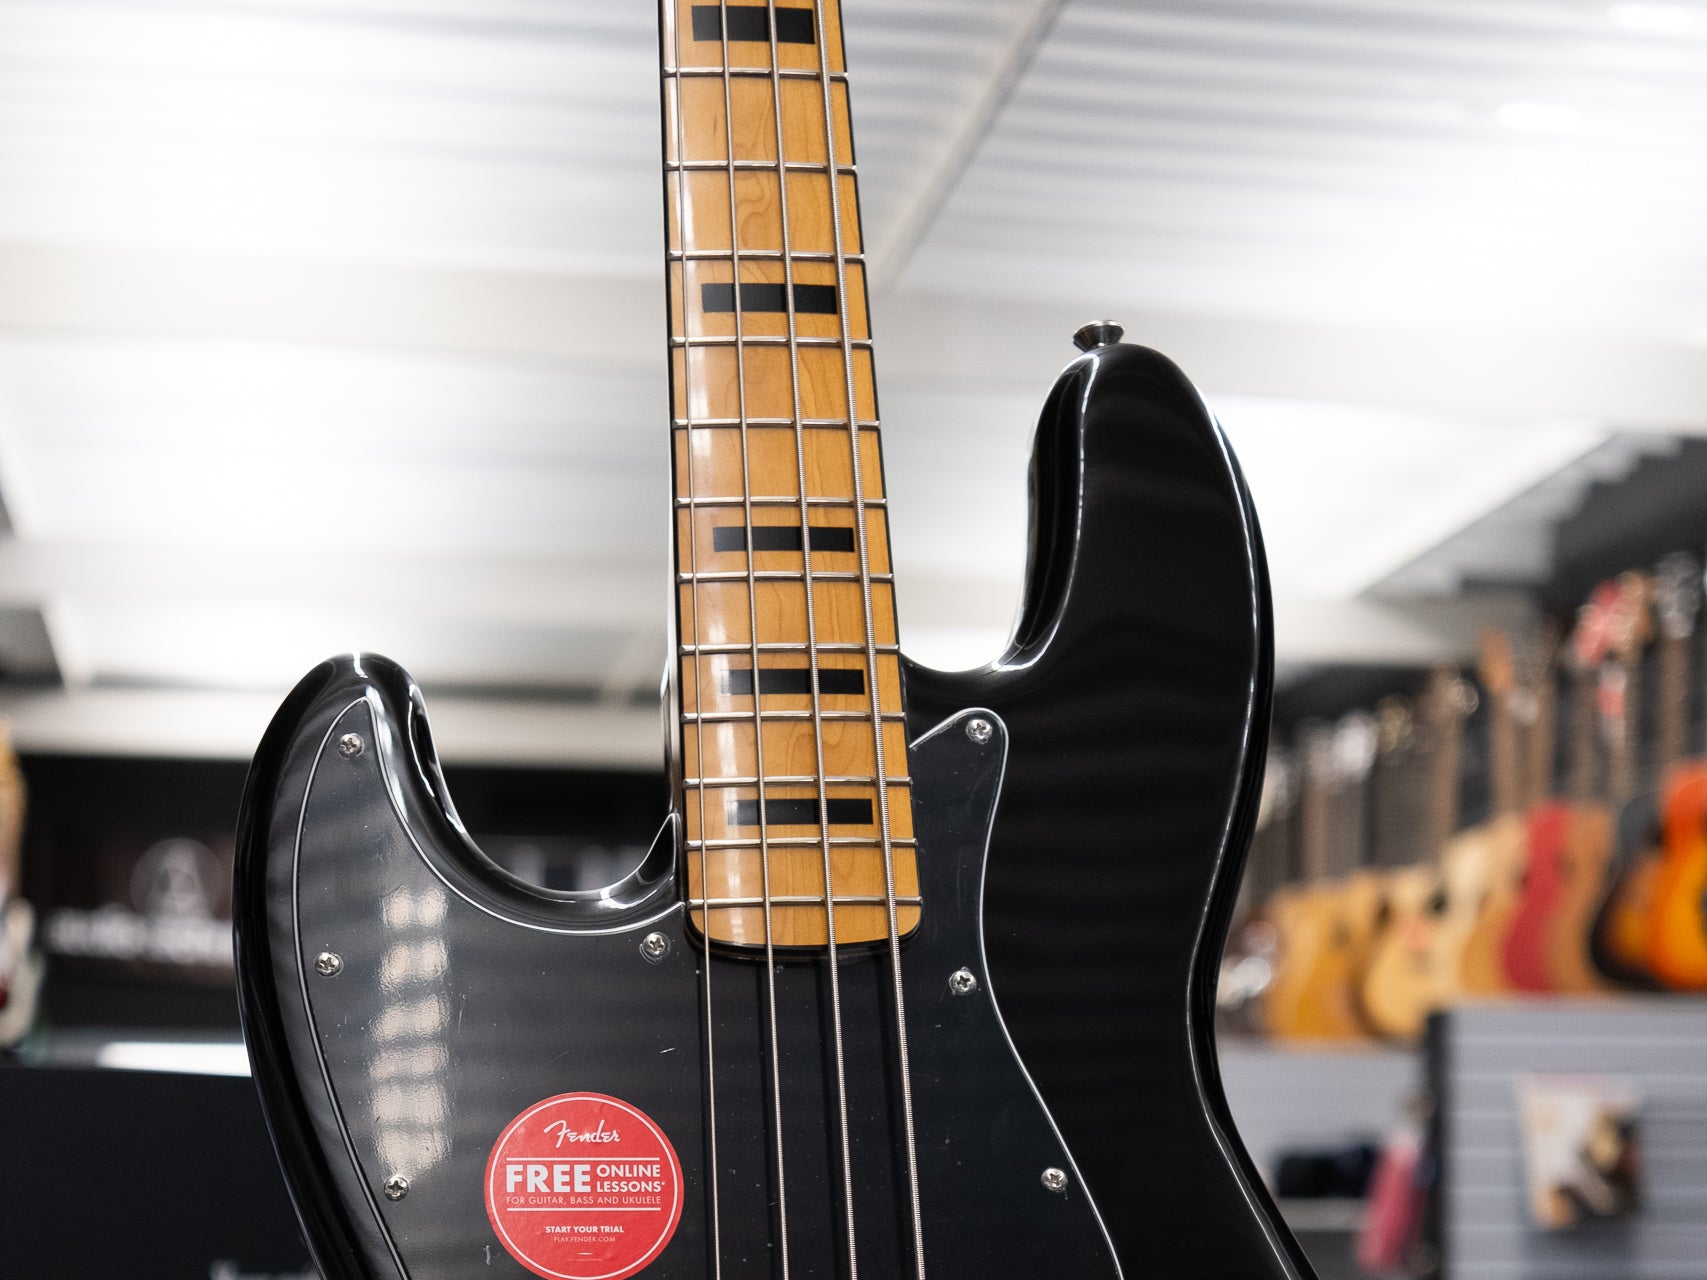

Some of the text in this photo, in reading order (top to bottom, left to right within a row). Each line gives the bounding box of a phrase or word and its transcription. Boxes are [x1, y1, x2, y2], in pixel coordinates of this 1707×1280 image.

[543, 1119, 621, 1149] Fender
[505, 1164, 661, 1193] FREE ONLINE
[506, 1196, 662, 1206] FOR GUITAR, BASS AND UKULELE
[572, 1225, 599, 1234] YOUR
[599, 1225, 625, 1234] TRIAL
